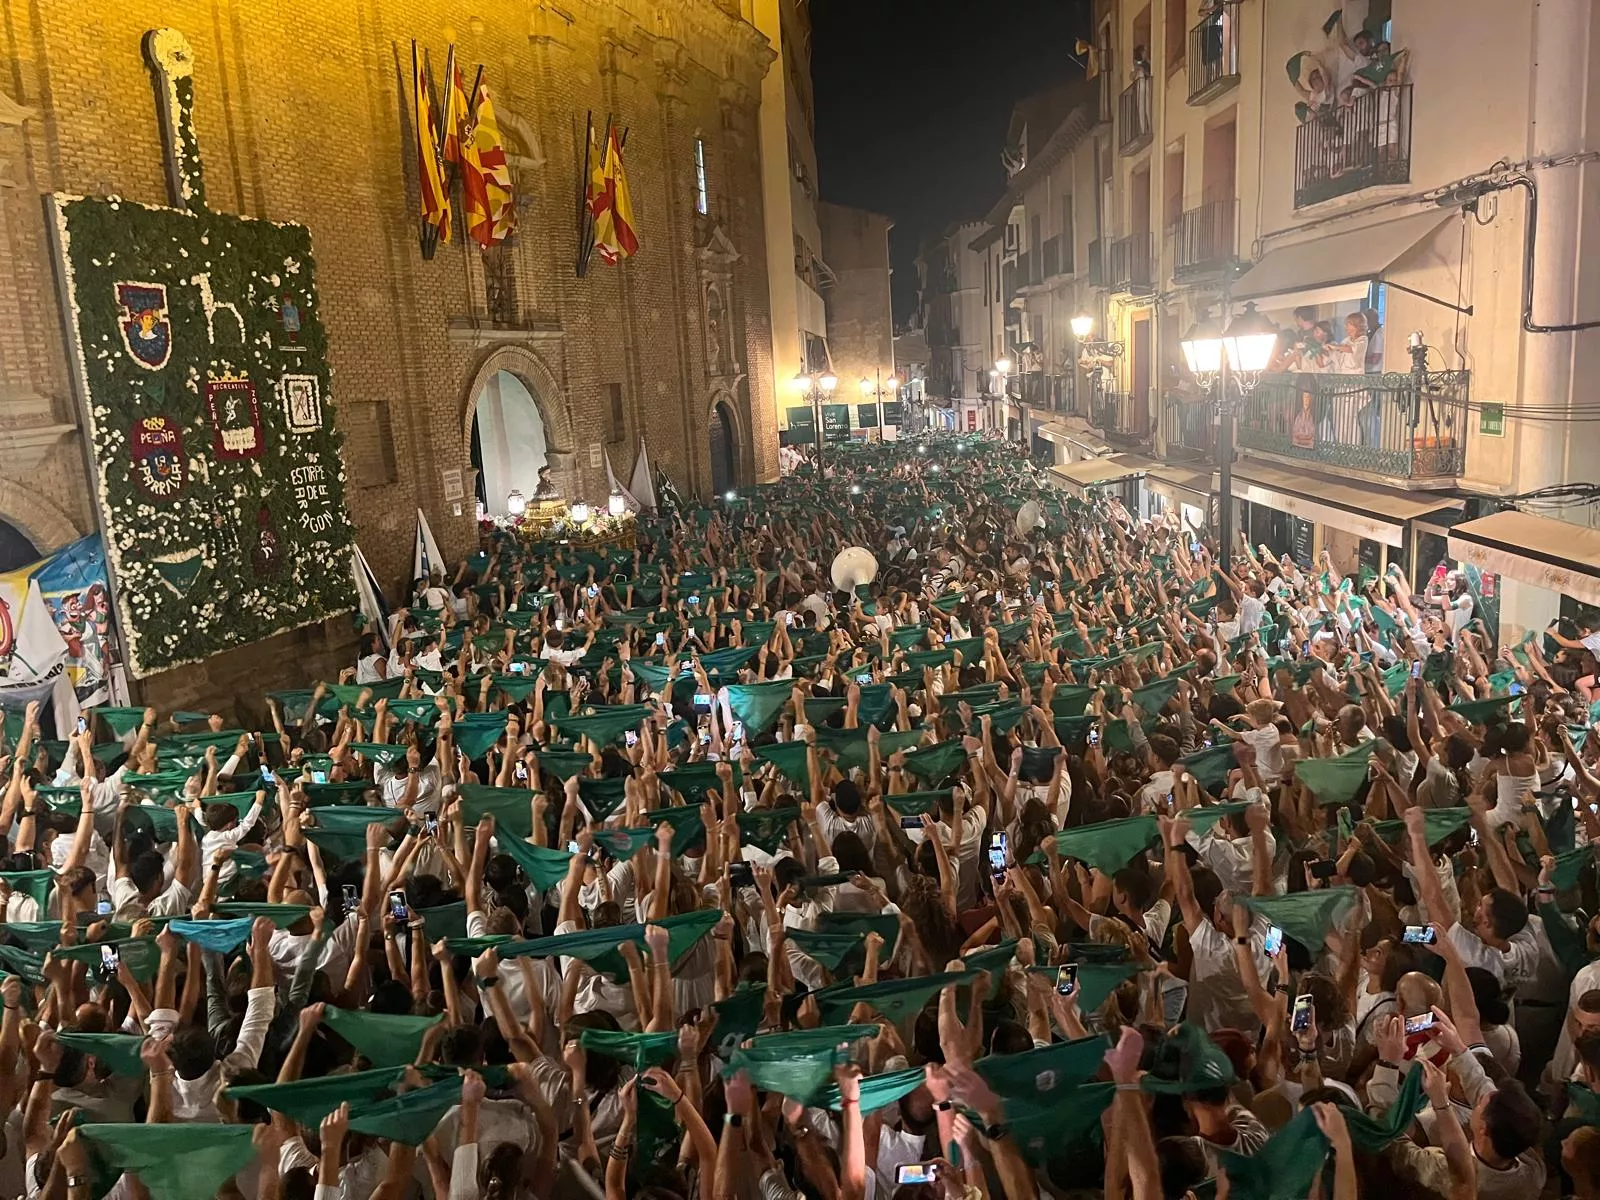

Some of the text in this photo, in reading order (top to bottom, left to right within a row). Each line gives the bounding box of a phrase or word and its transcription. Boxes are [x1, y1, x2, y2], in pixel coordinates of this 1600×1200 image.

[140, 429, 176, 444] PEÑA
[138, 464, 182, 495] PARRILLA
[290, 465, 325, 485] ESTIRPE
[306, 485, 319, 500] DE
